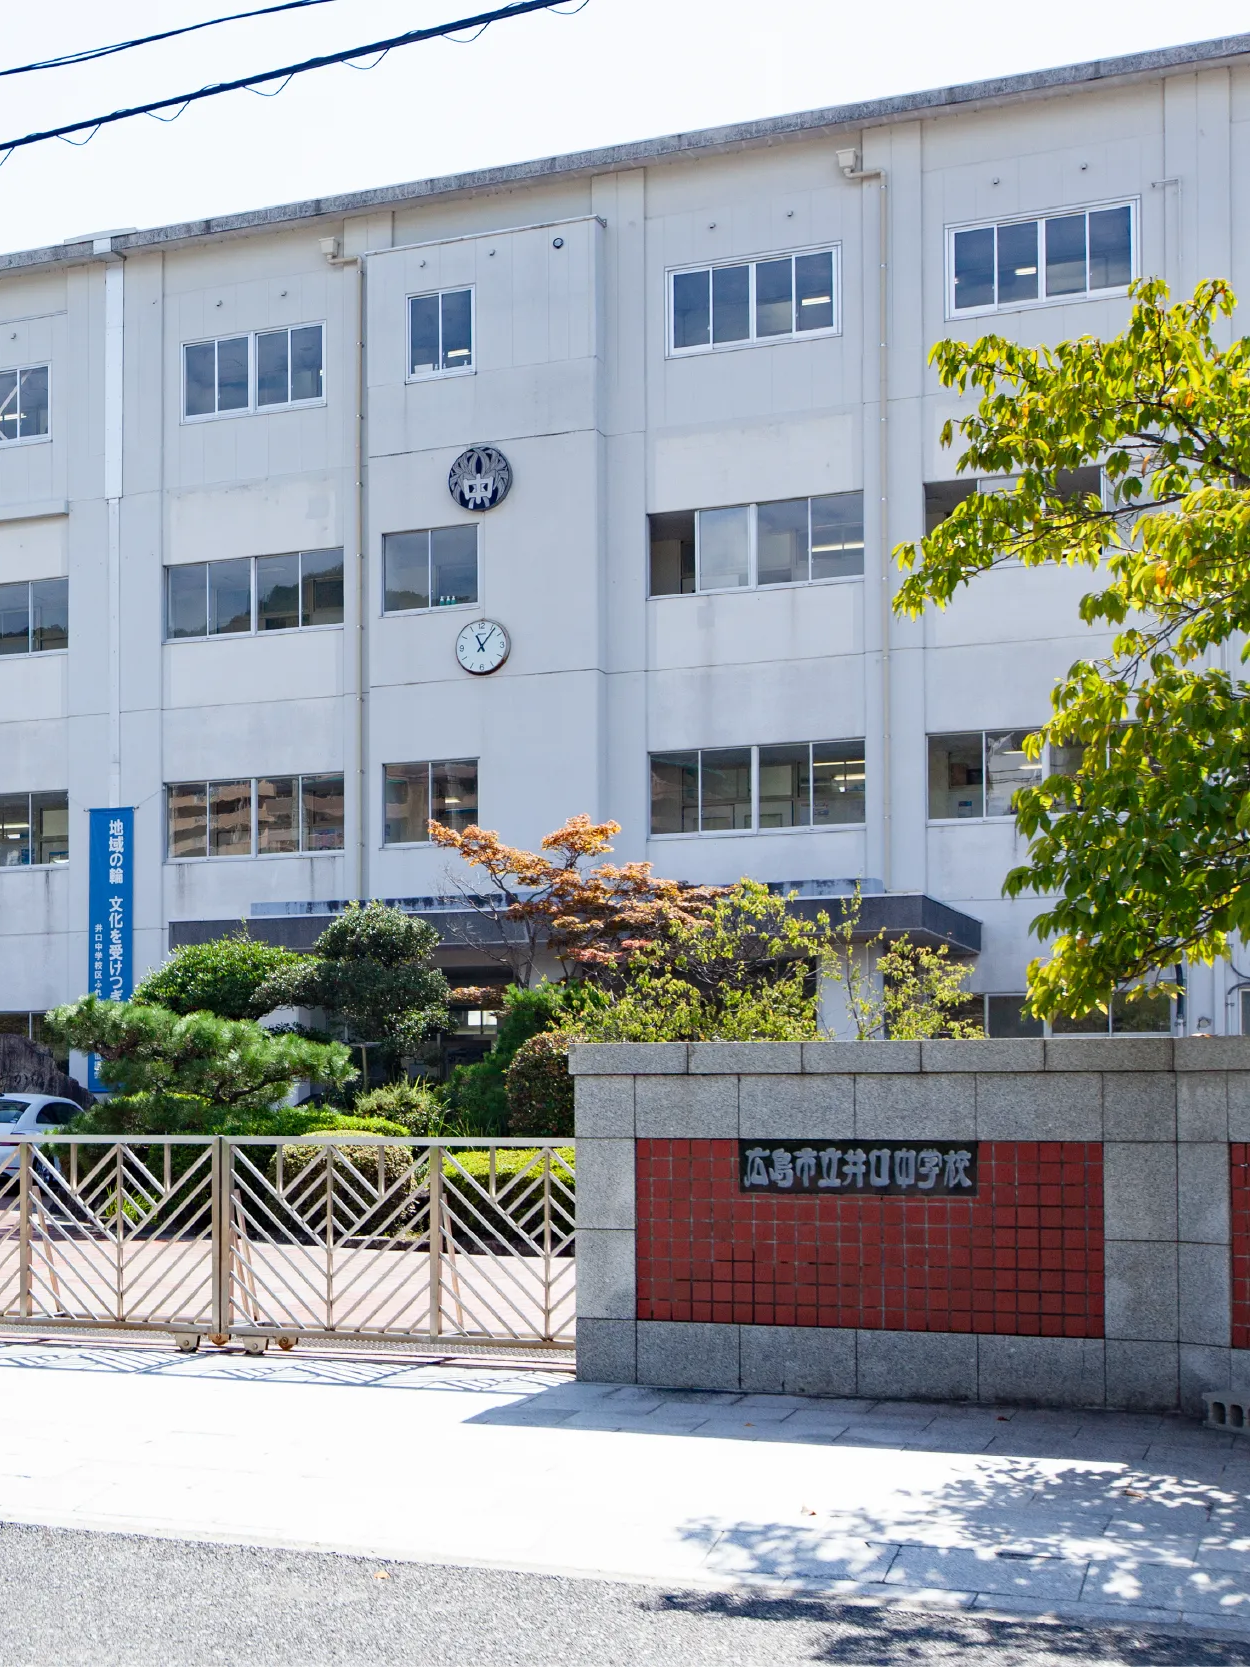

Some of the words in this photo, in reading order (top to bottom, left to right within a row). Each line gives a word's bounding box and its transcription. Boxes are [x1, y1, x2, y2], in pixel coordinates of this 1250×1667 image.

[459, 644, 465, 652] 9
[499, 641, 505, 649] 3
[479, 663, 485, 671] 6
[108, 818, 124, 885] 地域の輪
[94, 923, 103, 1002] 井口中学校区ふれ
[743, 1146, 973, 1190] 広島市立井口中学校
